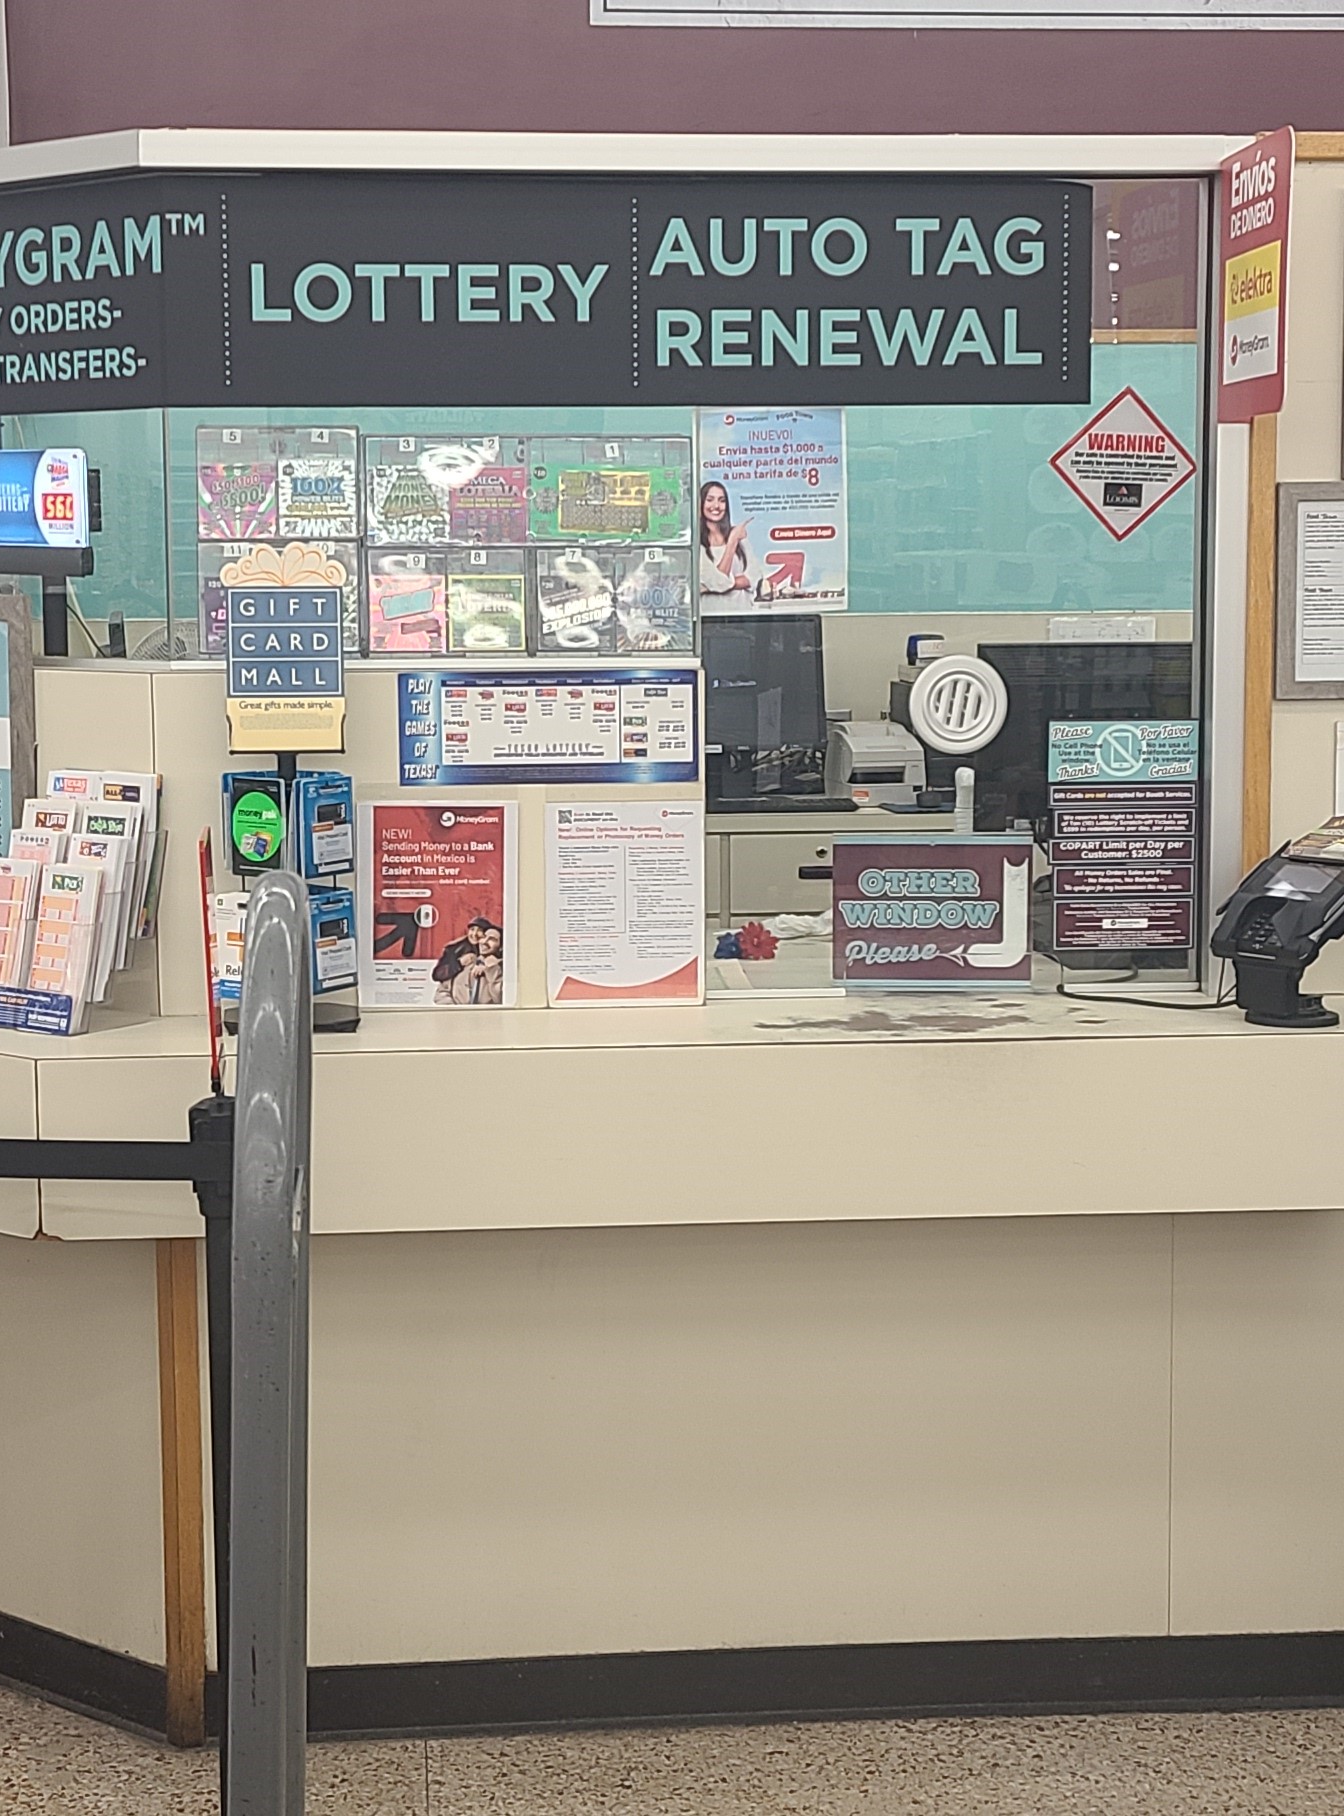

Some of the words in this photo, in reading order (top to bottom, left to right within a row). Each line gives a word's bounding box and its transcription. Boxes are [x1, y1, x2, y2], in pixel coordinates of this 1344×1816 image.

[1231, 150, 1276, 208] Envíos
[1242, 197, 1274, 236] DINERO
[649, 216, 869, 277] AUTO
[895, 216, 1047, 277] TAG
[251, 261, 608, 323] LOTTERY
[1239, 270, 1272, 303] elektra
[657, 309, 1043, 368] RENEWAL
[750, 445, 780, 455] hasta
[783, 444, 815, 454] $1,000
[1088, 433, 1166, 453] WARNING
[703, 458, 752, 469] cualquier
[756, 457, 784, 469] parte
[787, 456, 803, 466] del
[806, 455, 838, 465] mundo
[732, 472, 751, 480] una
[754, 469, 783, 479] tarifa
[786, 468, 798, 478] de
[801, 467, 819, 486] $8
[240, 598, 326, 616] GIFT
[240, 633, 329, 651] CARD
[241, 667, 326, 686] MALL
[408, 679, 432, 694] PLAY
[239, 701, 263, 710] Great
[265, 701, 281, 711] gifts
[283, 701, 306, 709] made
[411, 700, 430, 715] THE
[405, 721, 437, 736] GAMES
[1052, 726, 1092, 739] Please
[1139, 726, 1160, 740] Por
[1161, 725, 1192, 738] Favor
[414, 742, 427, 756] OF
[404, 764, 438, 779] TEXAS!
[1057, 763, 1100, 779] Thanks!
[1149, 762, 1193, 778] Gracias!
[456, 814, 499, 825] MoneyGram
[382, 828, 412, 840] NEW!
[382, 842, 419, 852] Sending
[421, 842, 449, 852] Money
[451, 842, 461, 851] to
[470, 842, 494, 851] Bank
[1060, 842, 1101, 850] COPART
[1103, 841, 1127, 850] Limit
[1129, 842, 1145, 851] per
[1147, 841, 1166, 851] Day
[1168, 841, 1184, 850] per
[382, 854, 421, 863] Account
[423, 854, 432, 863] in
[434, 854, 465, 863] Mexico
[467, 854, 475, 863] is
[1081, 851, 1130, 859] Customer:
[1132, 850, 1163, 858] $2500
[382, 867, 411, 876] Easier
[413, 867, 437, 876] Than
[438, 867, 460, 876] Ever
[859, 870, 979, 896] OTHER
[840, 901, 997, 928] WINDOW
[846, 940, 939, 966] Please
